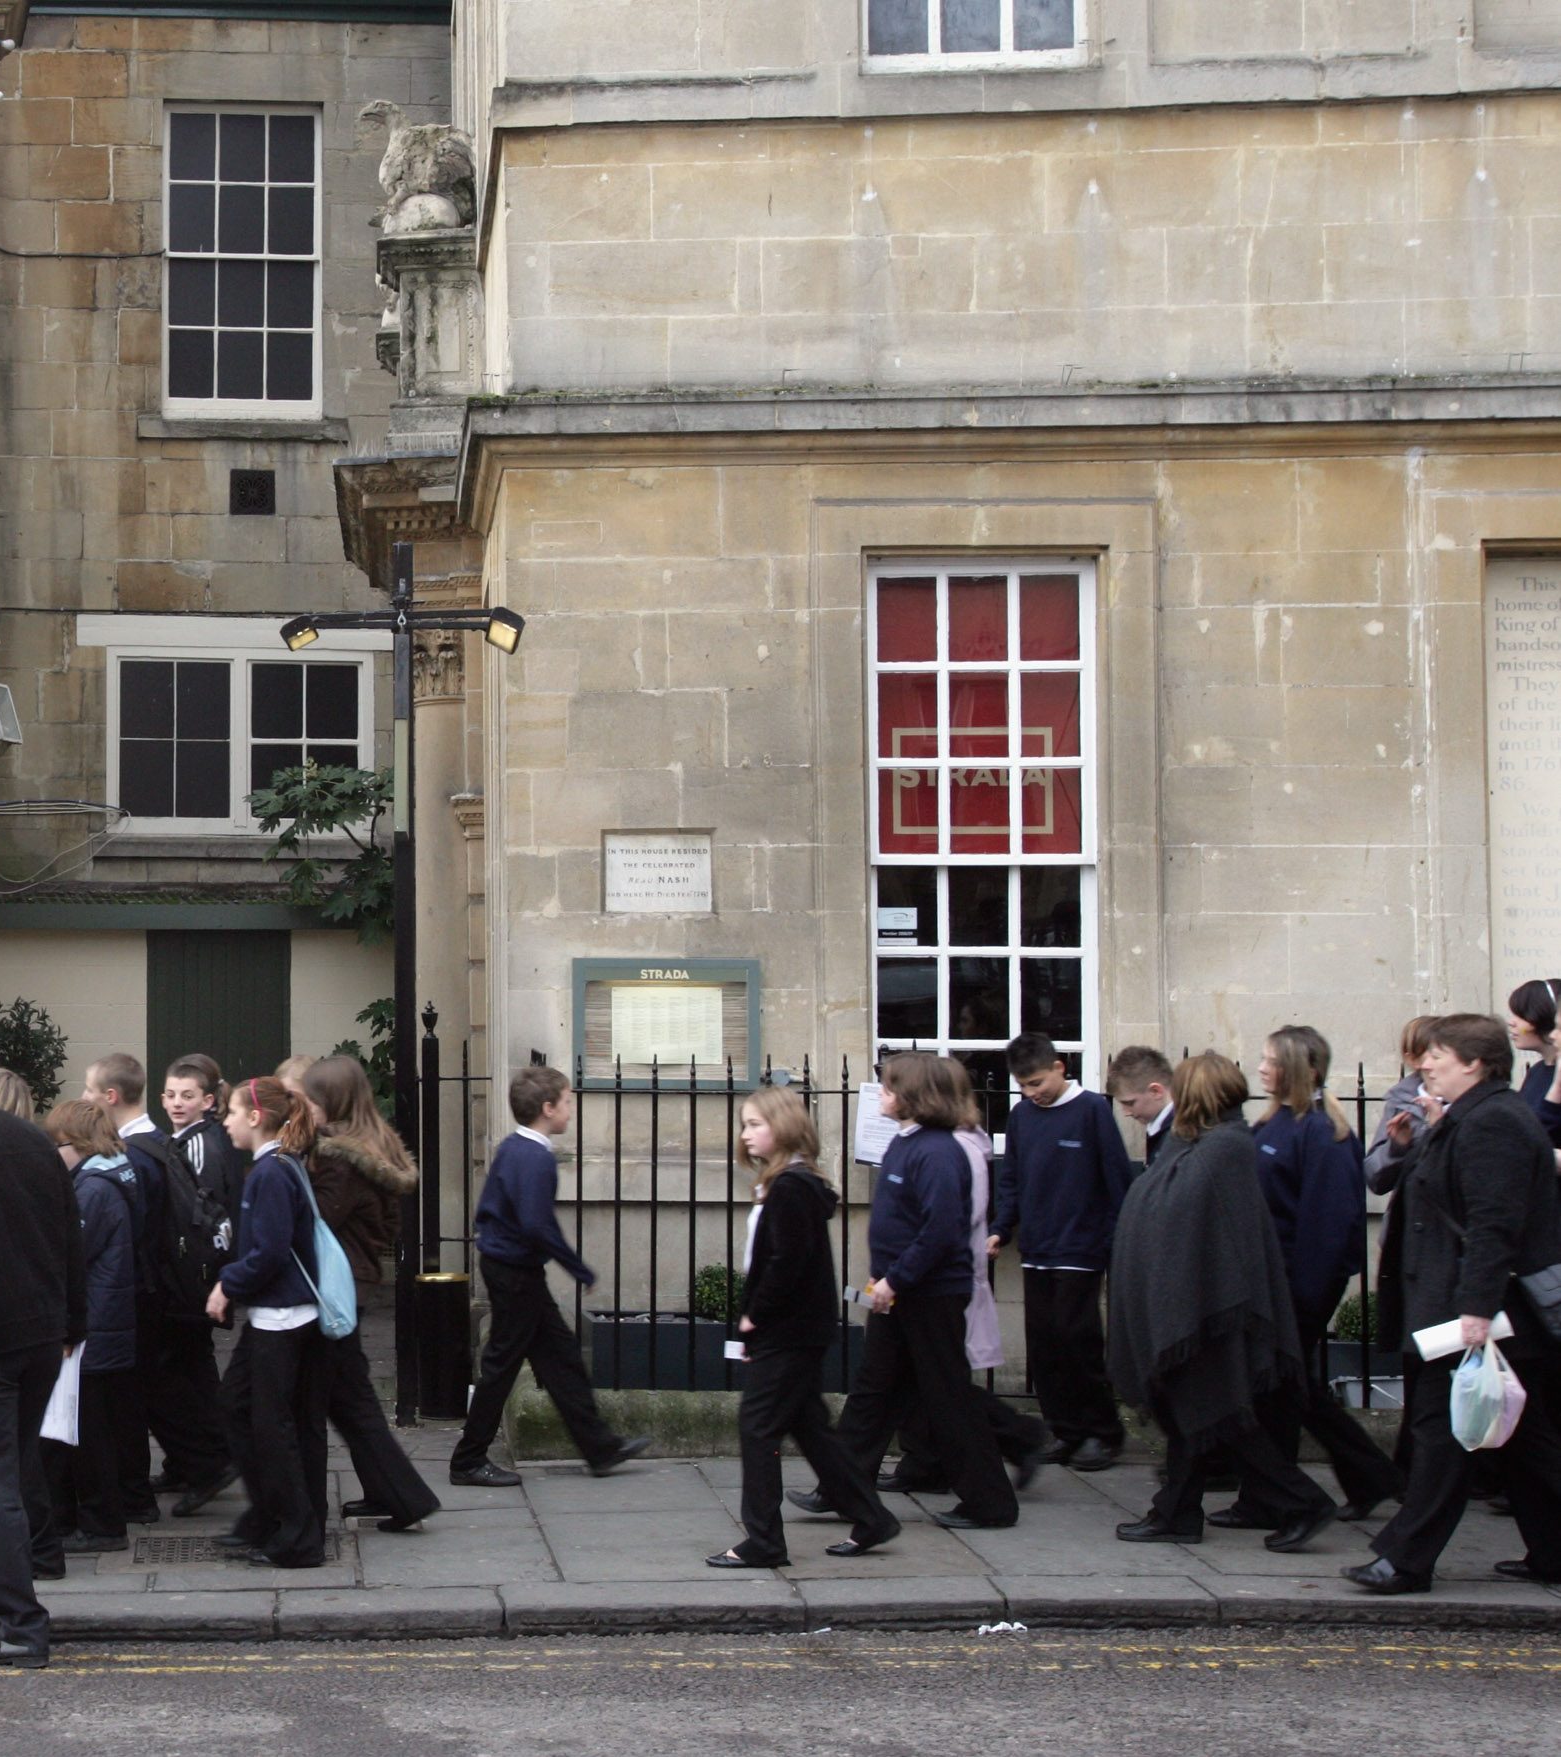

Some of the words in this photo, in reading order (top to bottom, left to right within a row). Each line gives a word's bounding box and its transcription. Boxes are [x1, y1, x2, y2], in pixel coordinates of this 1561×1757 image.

[1516, 576, 1558, 592] This
[1494, 597, 1543, 612] home
[1495, 617, 1536, 636] King
[1540, 616, 1561, 632] of
[1507, 676, 1560, 696] They
[1498, 696, 1518, 711] of
[1527, 696, 1557, 711] the
[1499, 716, 1544, 731] their
[1499, 737, 1542, 752] until
[1498, 756, 1516, 772] in
[1521, 802, 1551, 817] We
[658, 876, 689, 884] NASH
[1503, 883, 1542, 898] that
[640, 969, 690, 980] STRADA
